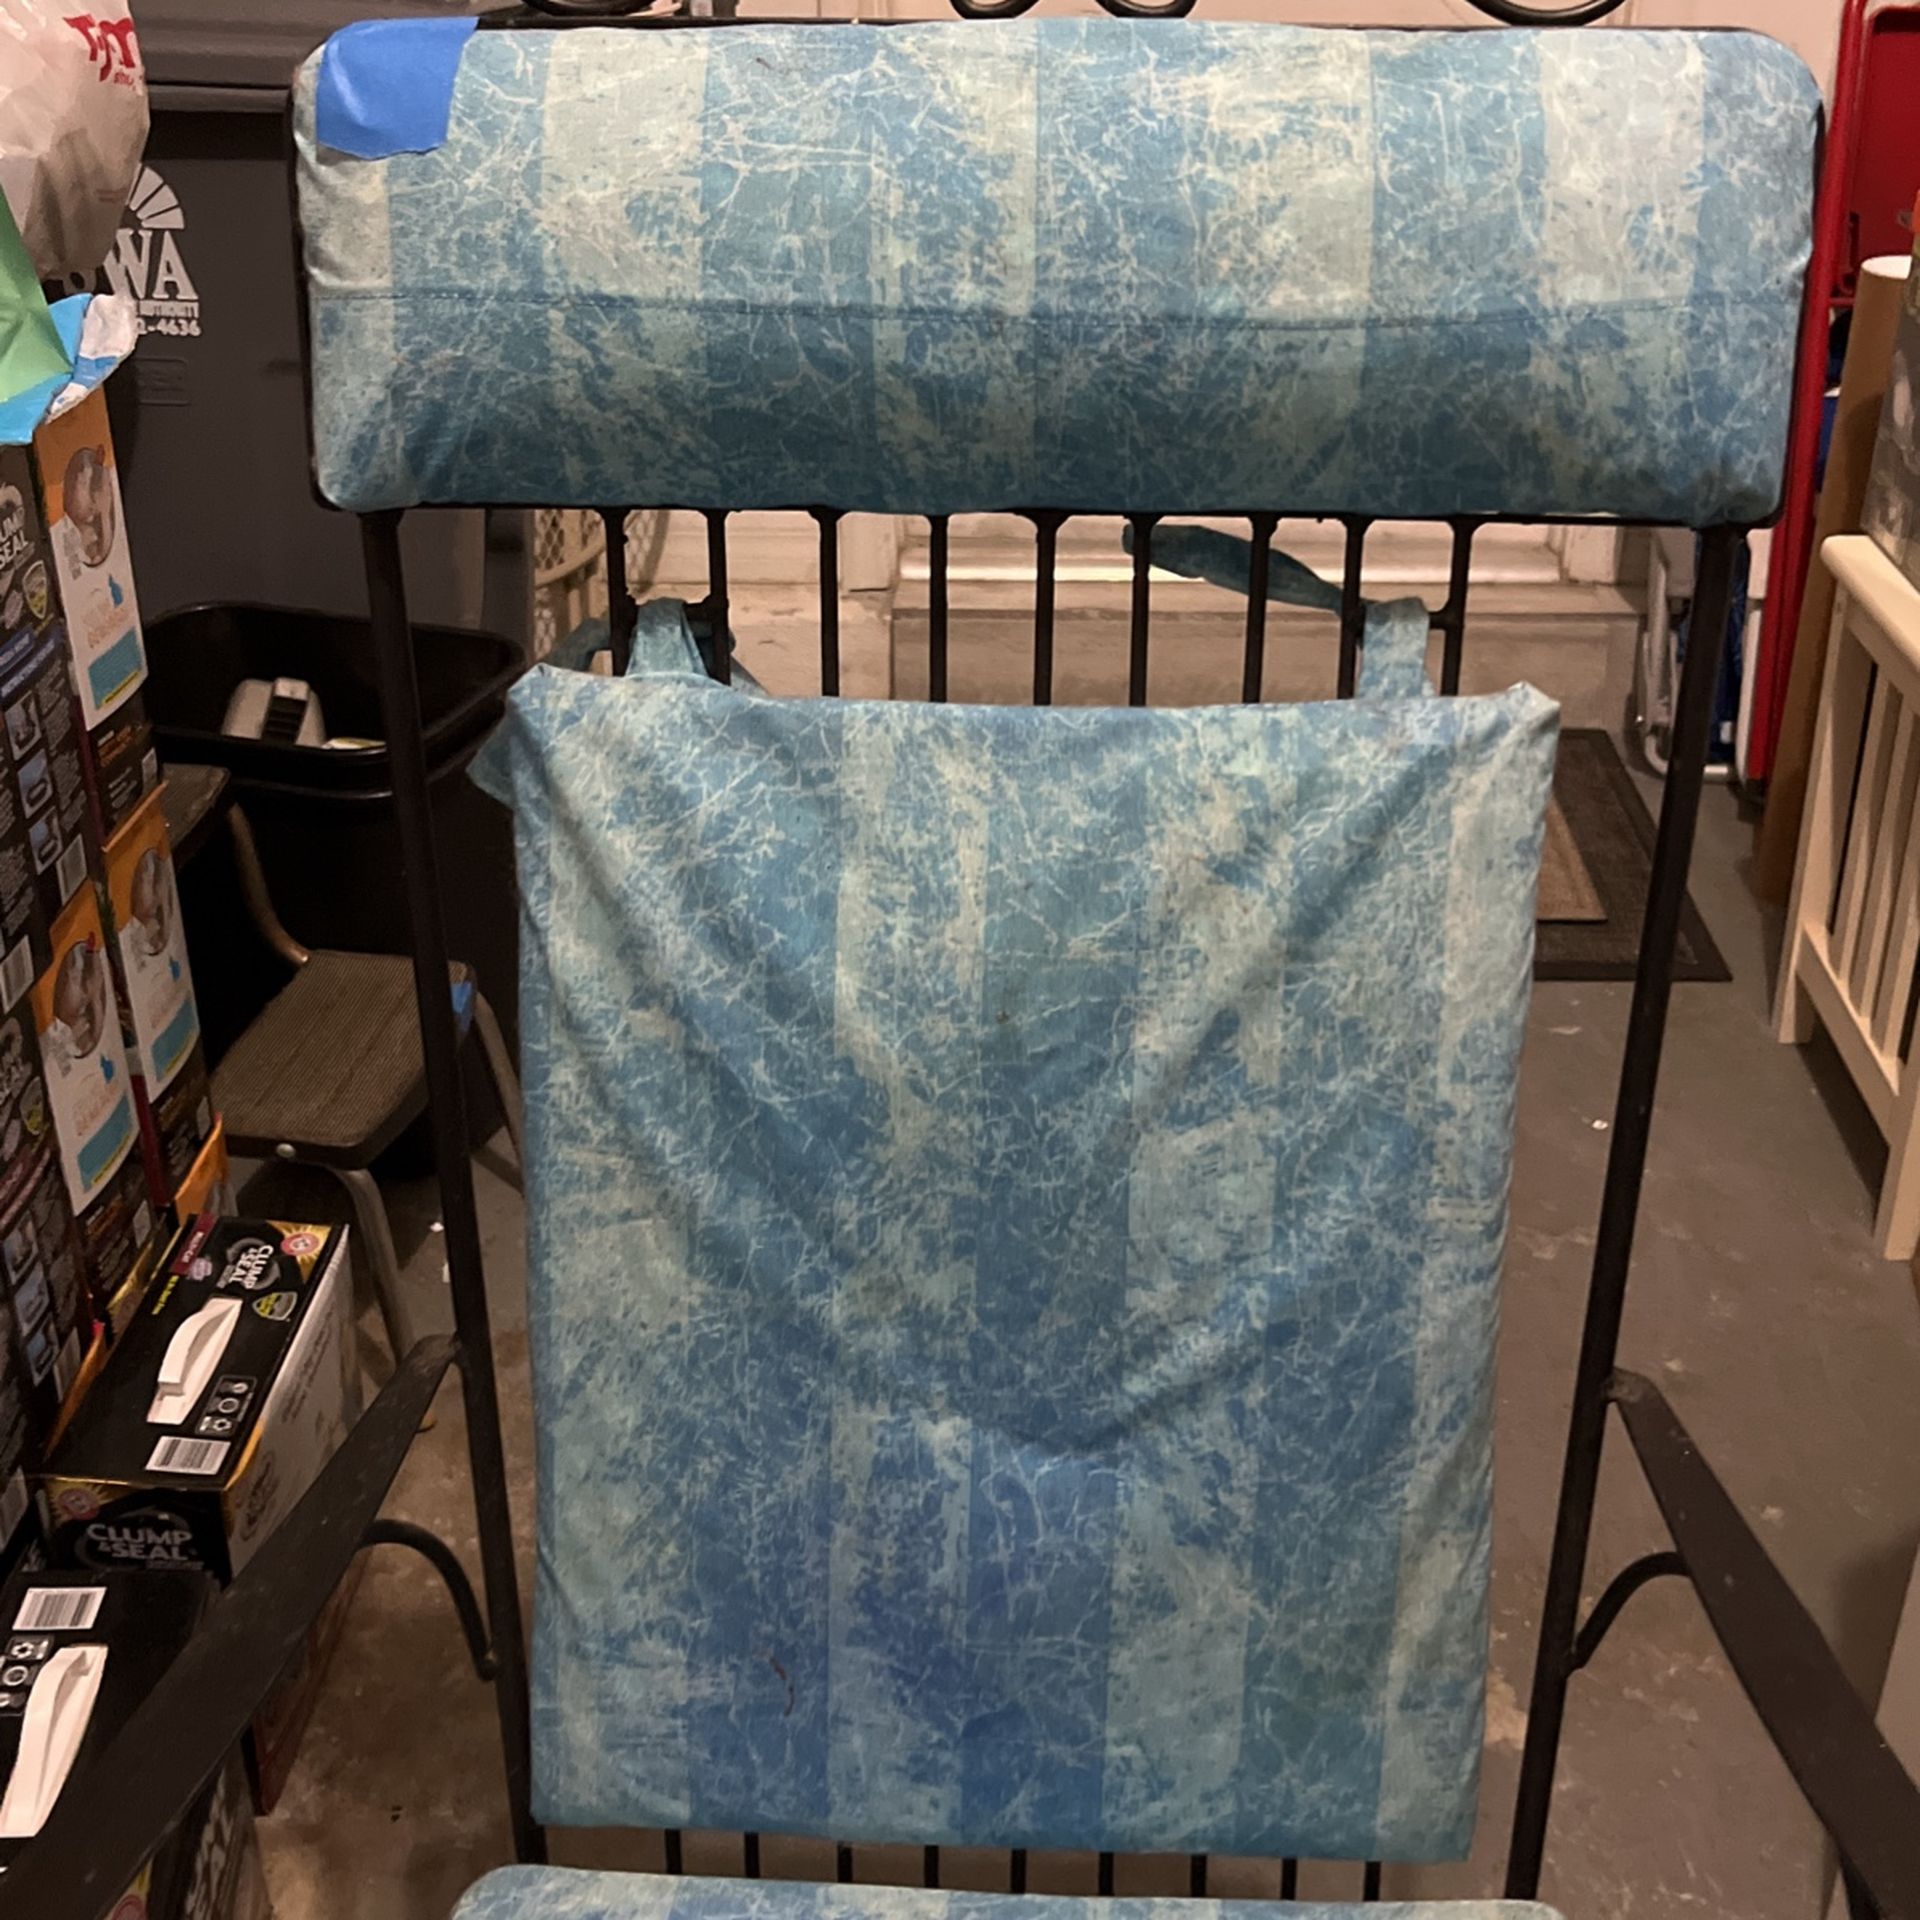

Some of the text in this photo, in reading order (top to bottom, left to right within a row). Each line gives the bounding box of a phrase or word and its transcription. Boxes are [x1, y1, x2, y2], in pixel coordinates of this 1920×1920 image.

[243, 1245, 274, 1289] CLUMP
[87, 1523, 192, 1545] CLUMP
[111, 1543, 189, 1561] SEAL
